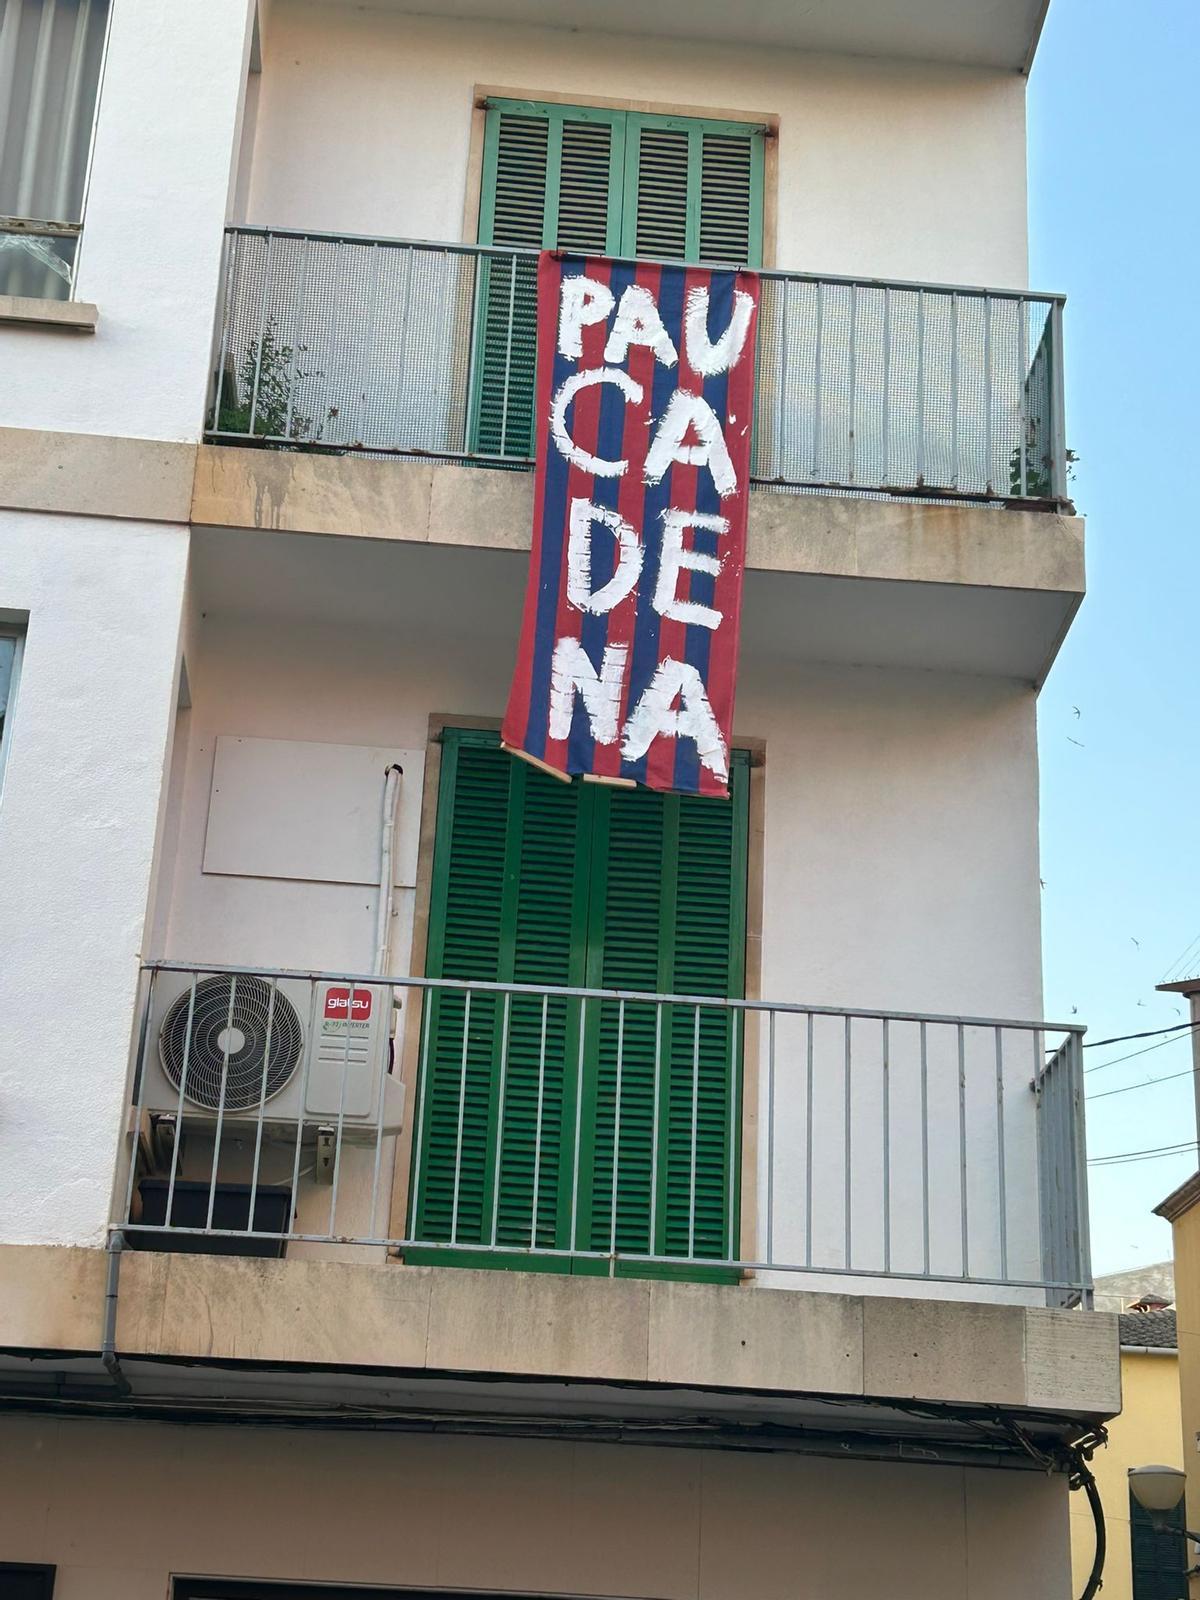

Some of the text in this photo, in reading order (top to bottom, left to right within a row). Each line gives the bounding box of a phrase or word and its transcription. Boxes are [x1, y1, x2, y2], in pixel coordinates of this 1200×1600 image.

[557, 273, 755, 376] PAU
[549, 366, 738, 497] CA
[567, 497, 730, 630] DE
[549, 636, 728, 783] NA
